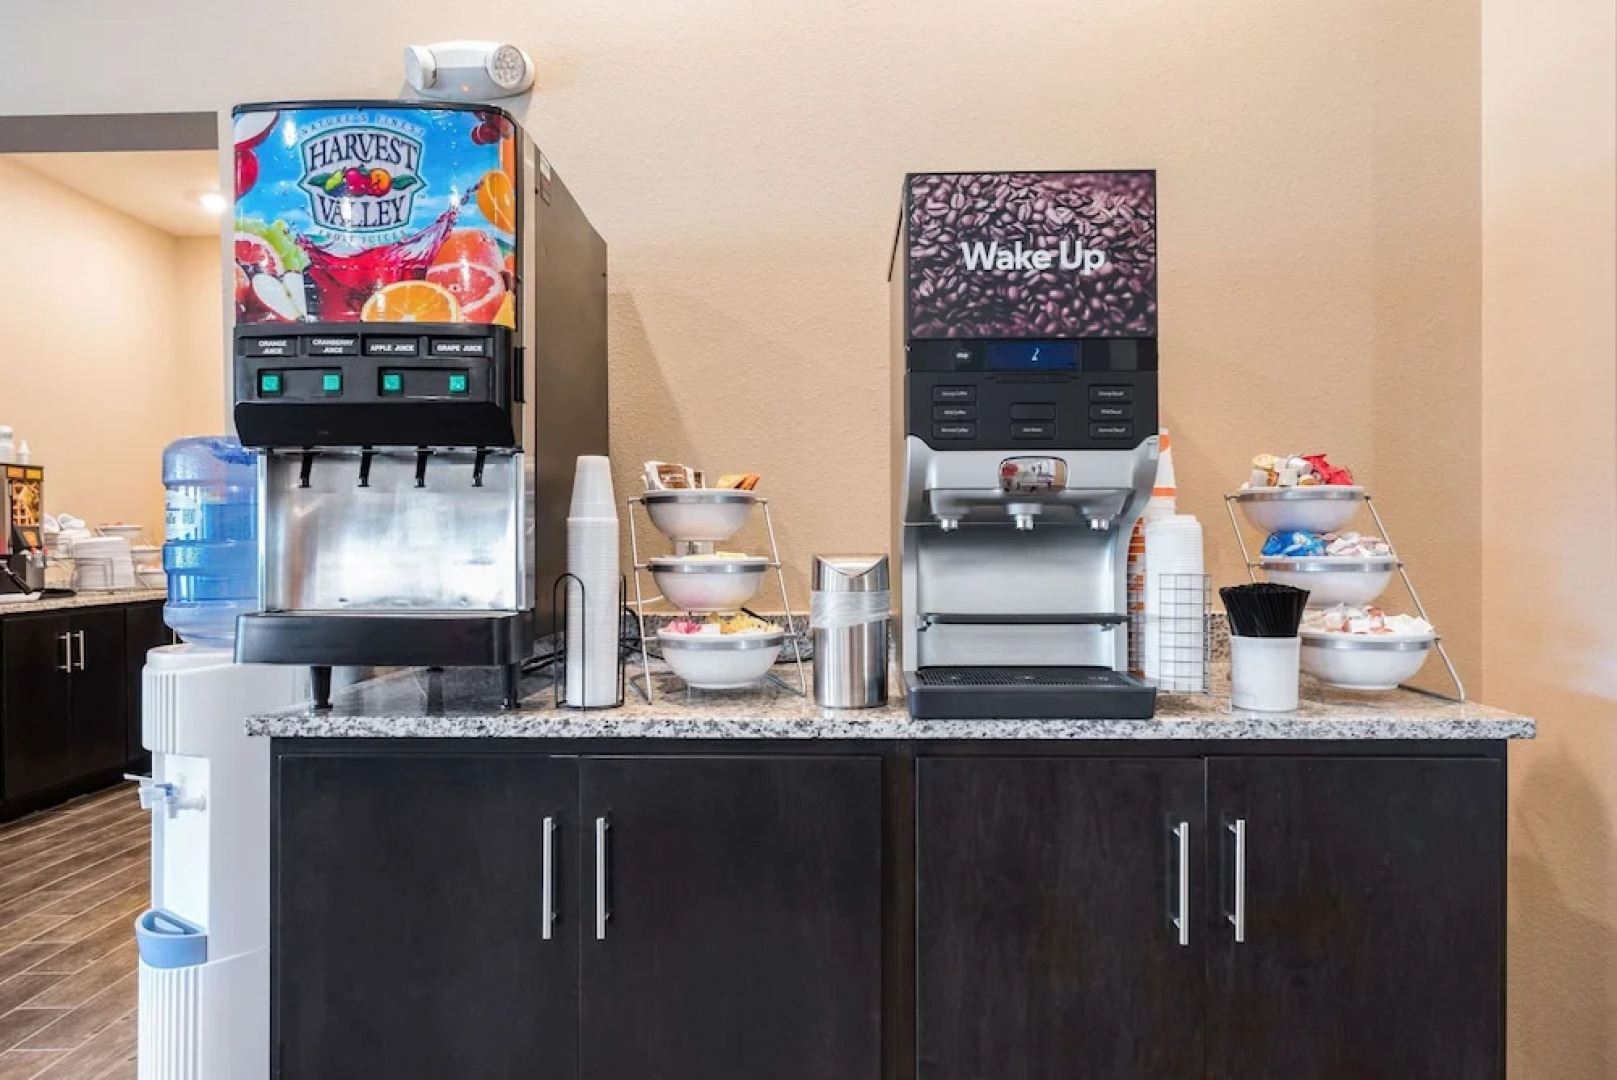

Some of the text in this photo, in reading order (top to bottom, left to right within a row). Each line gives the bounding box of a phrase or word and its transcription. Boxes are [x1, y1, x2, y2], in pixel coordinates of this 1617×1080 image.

[309, 133, 418, 171] HARVEST
[317, 194, 406, 227] VALLEY
[961, 240, 1106, 276] Wake Up
[262, 347, 284, 355] JUICE
[322, 346, 344, 354] JUICE
[369, 344, 415, 352] APPLE JUICE
